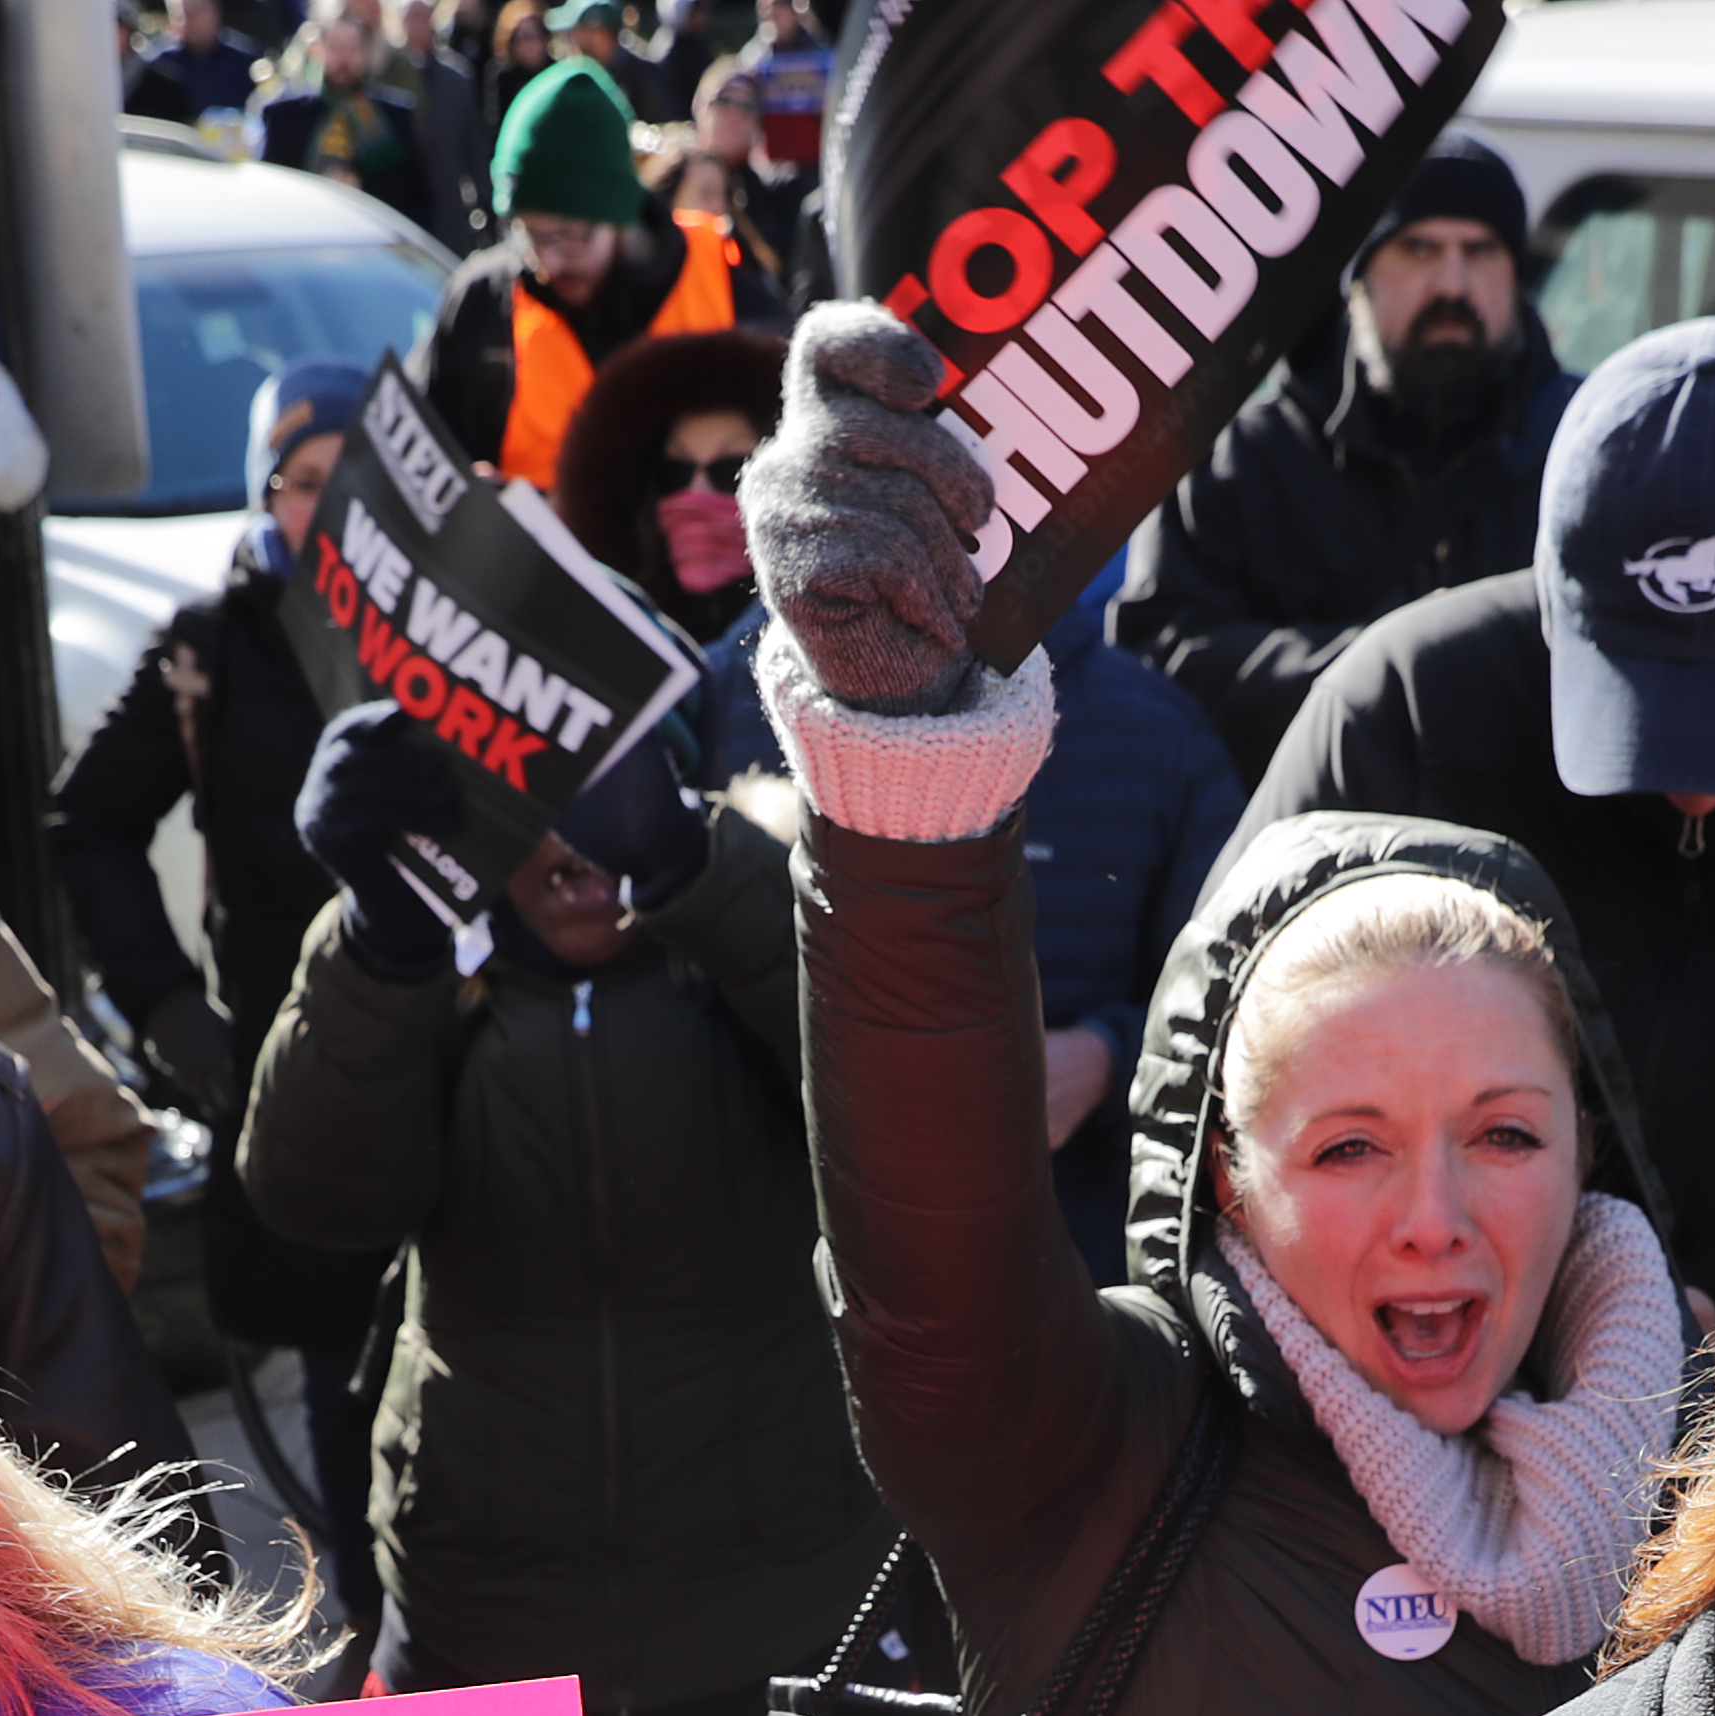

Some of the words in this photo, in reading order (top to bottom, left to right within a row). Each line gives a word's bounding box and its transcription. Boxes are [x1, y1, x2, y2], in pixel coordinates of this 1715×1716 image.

[884, 116, 1118, 399] TOP
[936, 0, 1472, 584] HUTDOWN
[313, 530, 359, 629] TO
[356, 601, 550, 794] WORK
[341, 497, 414, 617] WE
[405, 576, 614, 753] WANT
